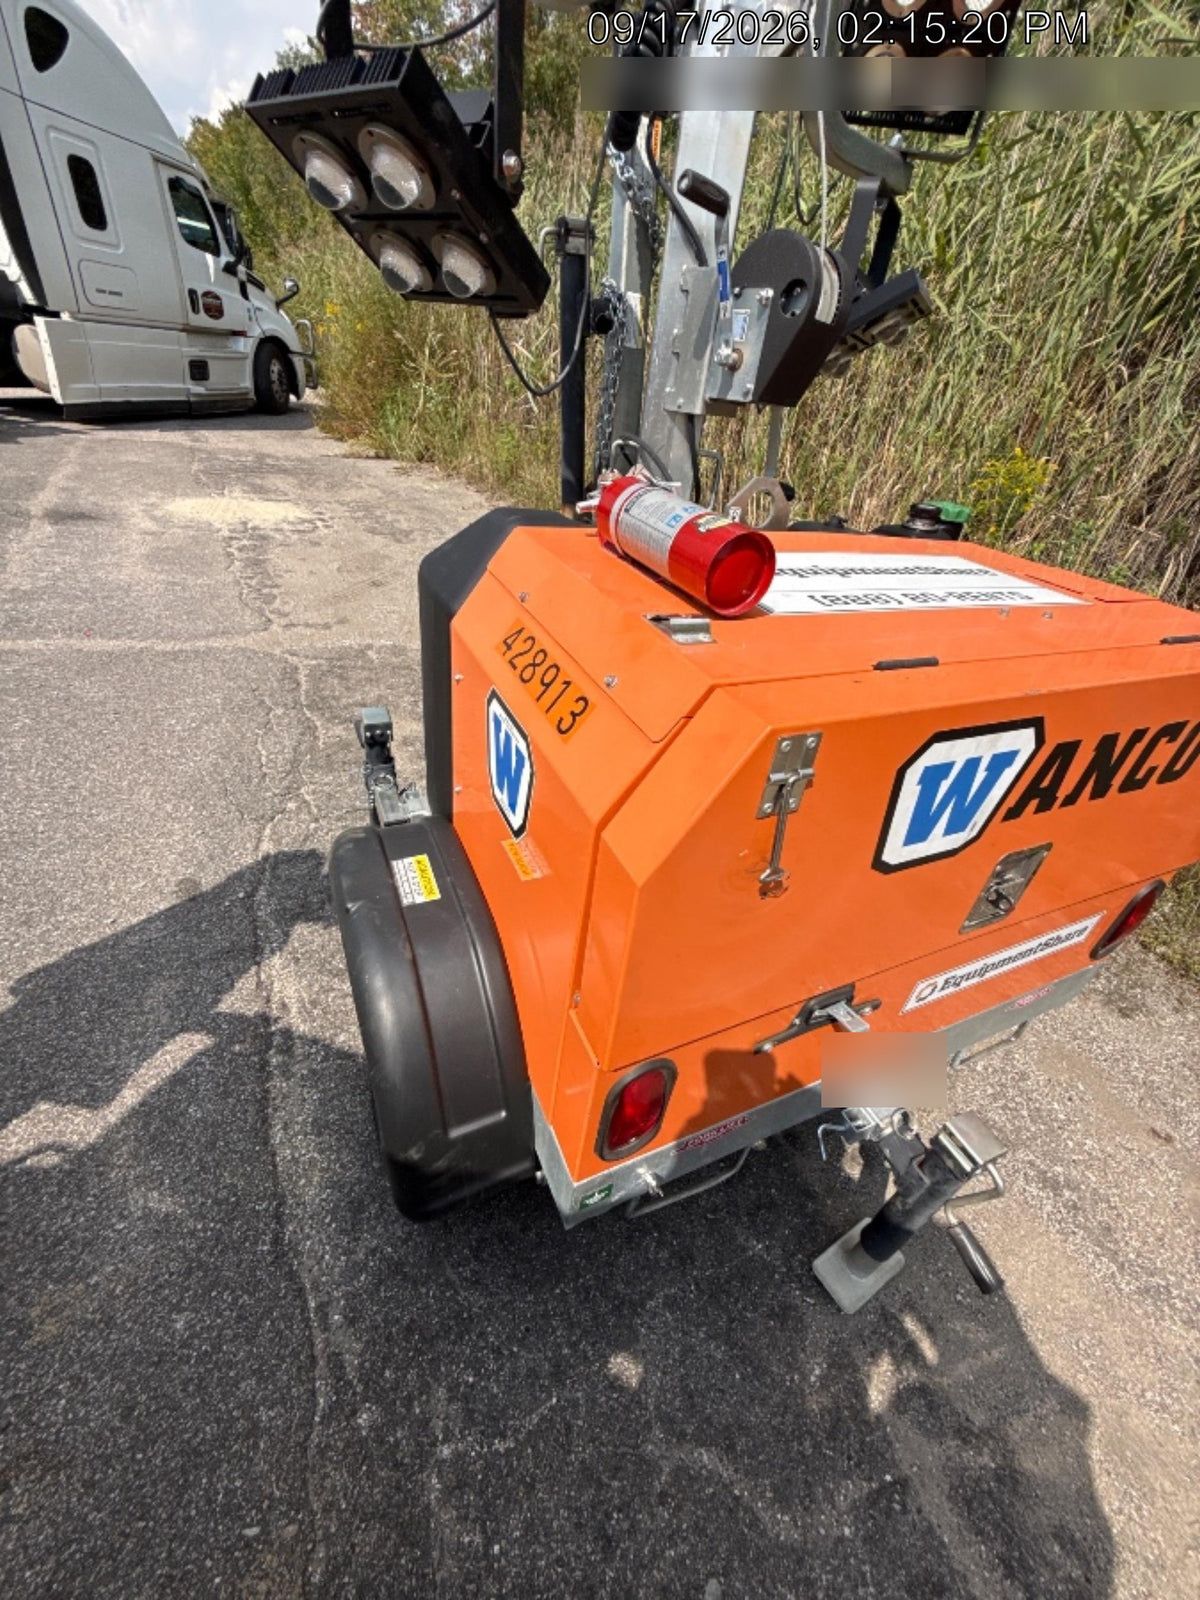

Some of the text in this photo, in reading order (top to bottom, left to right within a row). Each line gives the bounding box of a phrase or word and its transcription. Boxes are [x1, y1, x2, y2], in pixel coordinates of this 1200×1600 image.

[502, 627, 589, 735] 428913
[492, 711, 526, 817] W
[938, 925, 1090, 992] EquipmentShare
